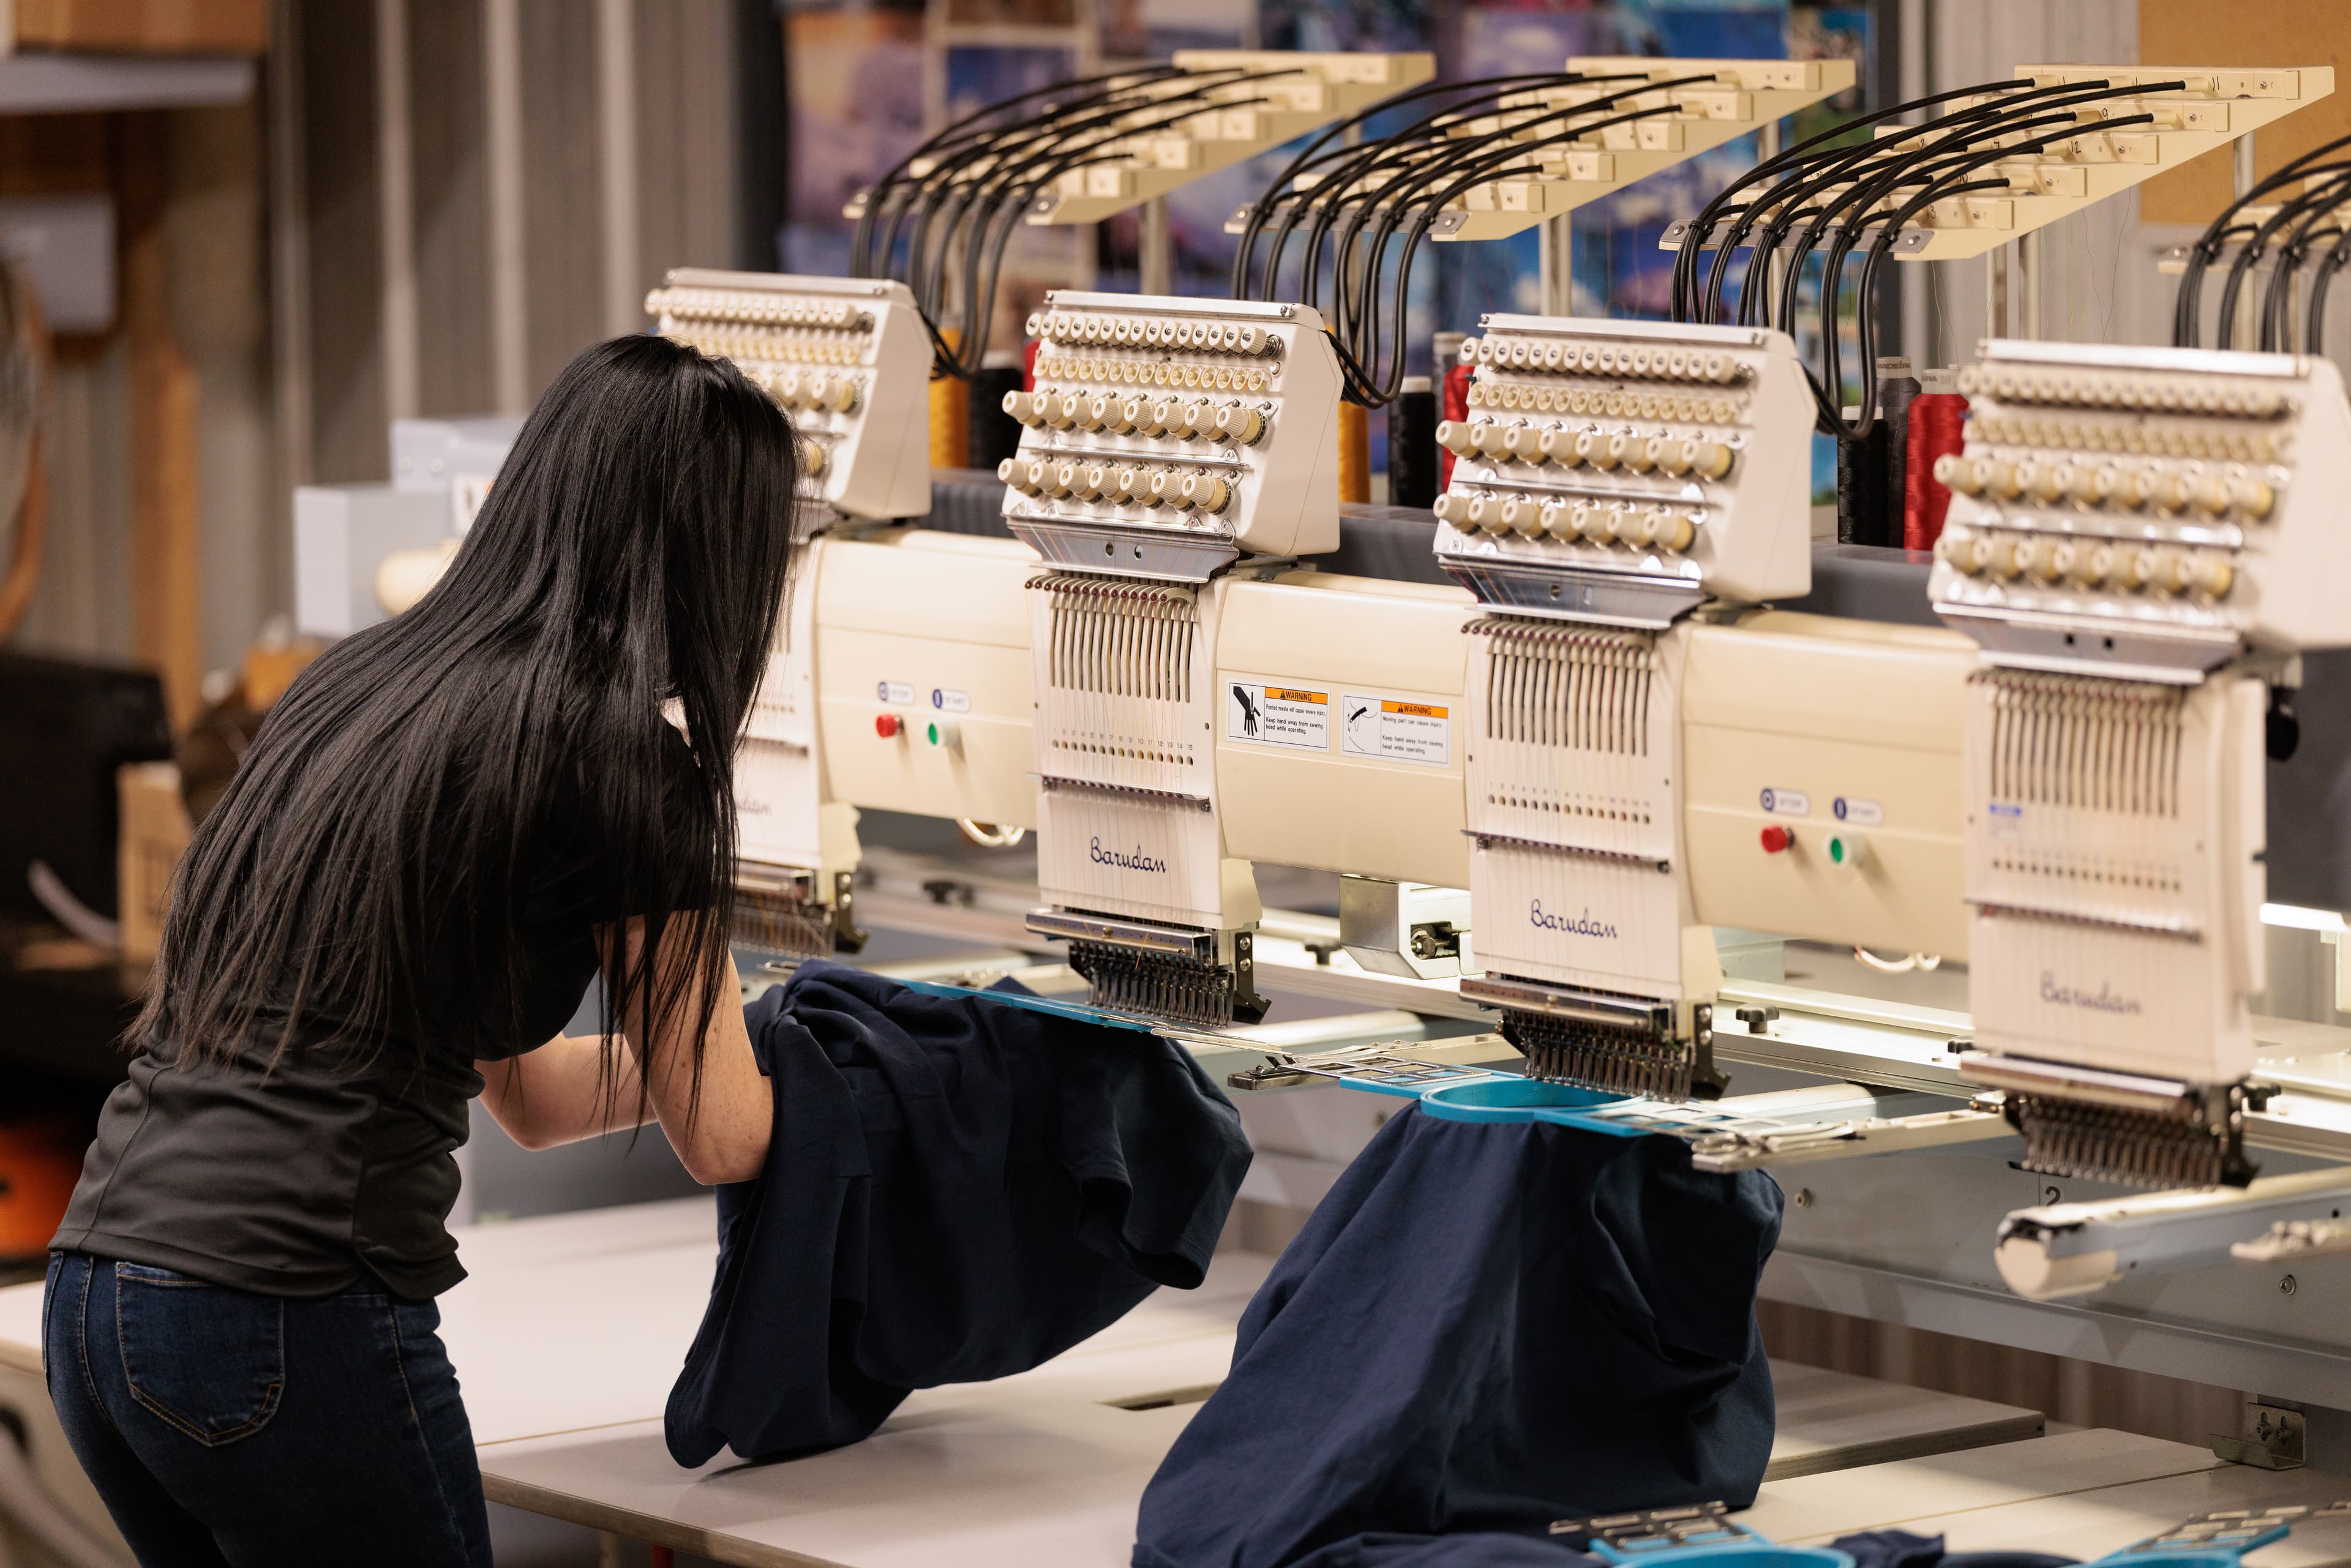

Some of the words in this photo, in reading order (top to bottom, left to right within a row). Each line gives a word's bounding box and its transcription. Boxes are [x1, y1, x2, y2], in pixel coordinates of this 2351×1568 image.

[2071, 140, 2082, 154] 12
[1286, 691, 1311, 701] WARNING
[1403, 704, 1431, 716] WARNING
[1090, 836, 1166, 874] Barudan
[1531, 899, 1617, 939] Barudan
[2045, 1186, 2061, 1207] 2
